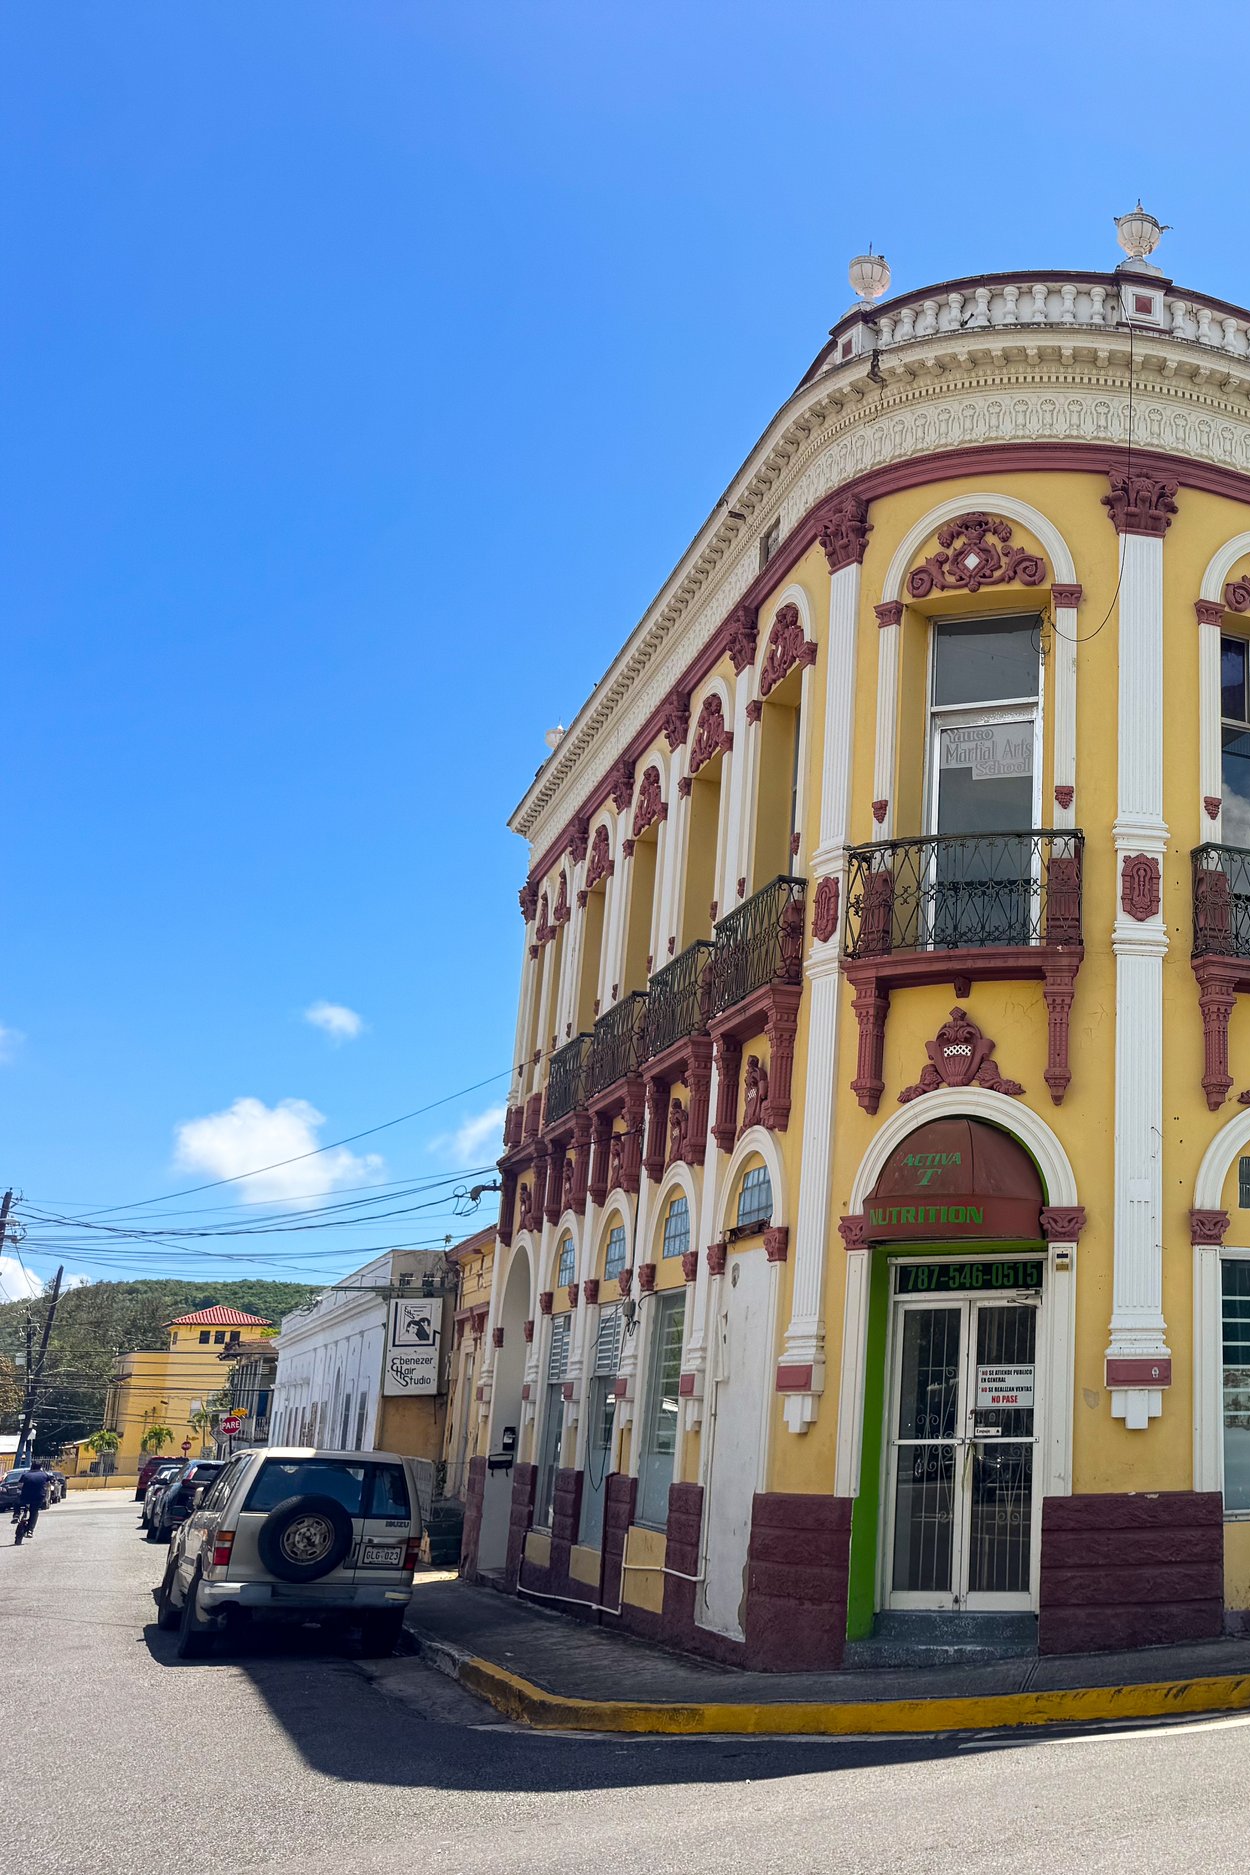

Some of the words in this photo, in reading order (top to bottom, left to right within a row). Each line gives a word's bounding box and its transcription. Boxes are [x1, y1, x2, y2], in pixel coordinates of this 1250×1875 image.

[945, 728, 994, 743] Yauco
[945, 741, 995, 764] Martial
[1003, 739, 1033, 759] Arts
[976, 757, 1032, 776] School
[901, 1152, 962, 1167] ACTIVA
[915, 1169, 942, 1186] T
[869, 1206, 984, 1226] NUTRITION
[906, 1262, 1038, 1290] 787-546-0515
[391, 1356, 433, 1372] Ebenezer
[392, 1373, 431, 1387] Studio
[991, 1395, 1001, 1404] NO
[1002, 1395, 1018, 1404] PASE
[222, 1421, 240, 1430] PARE
